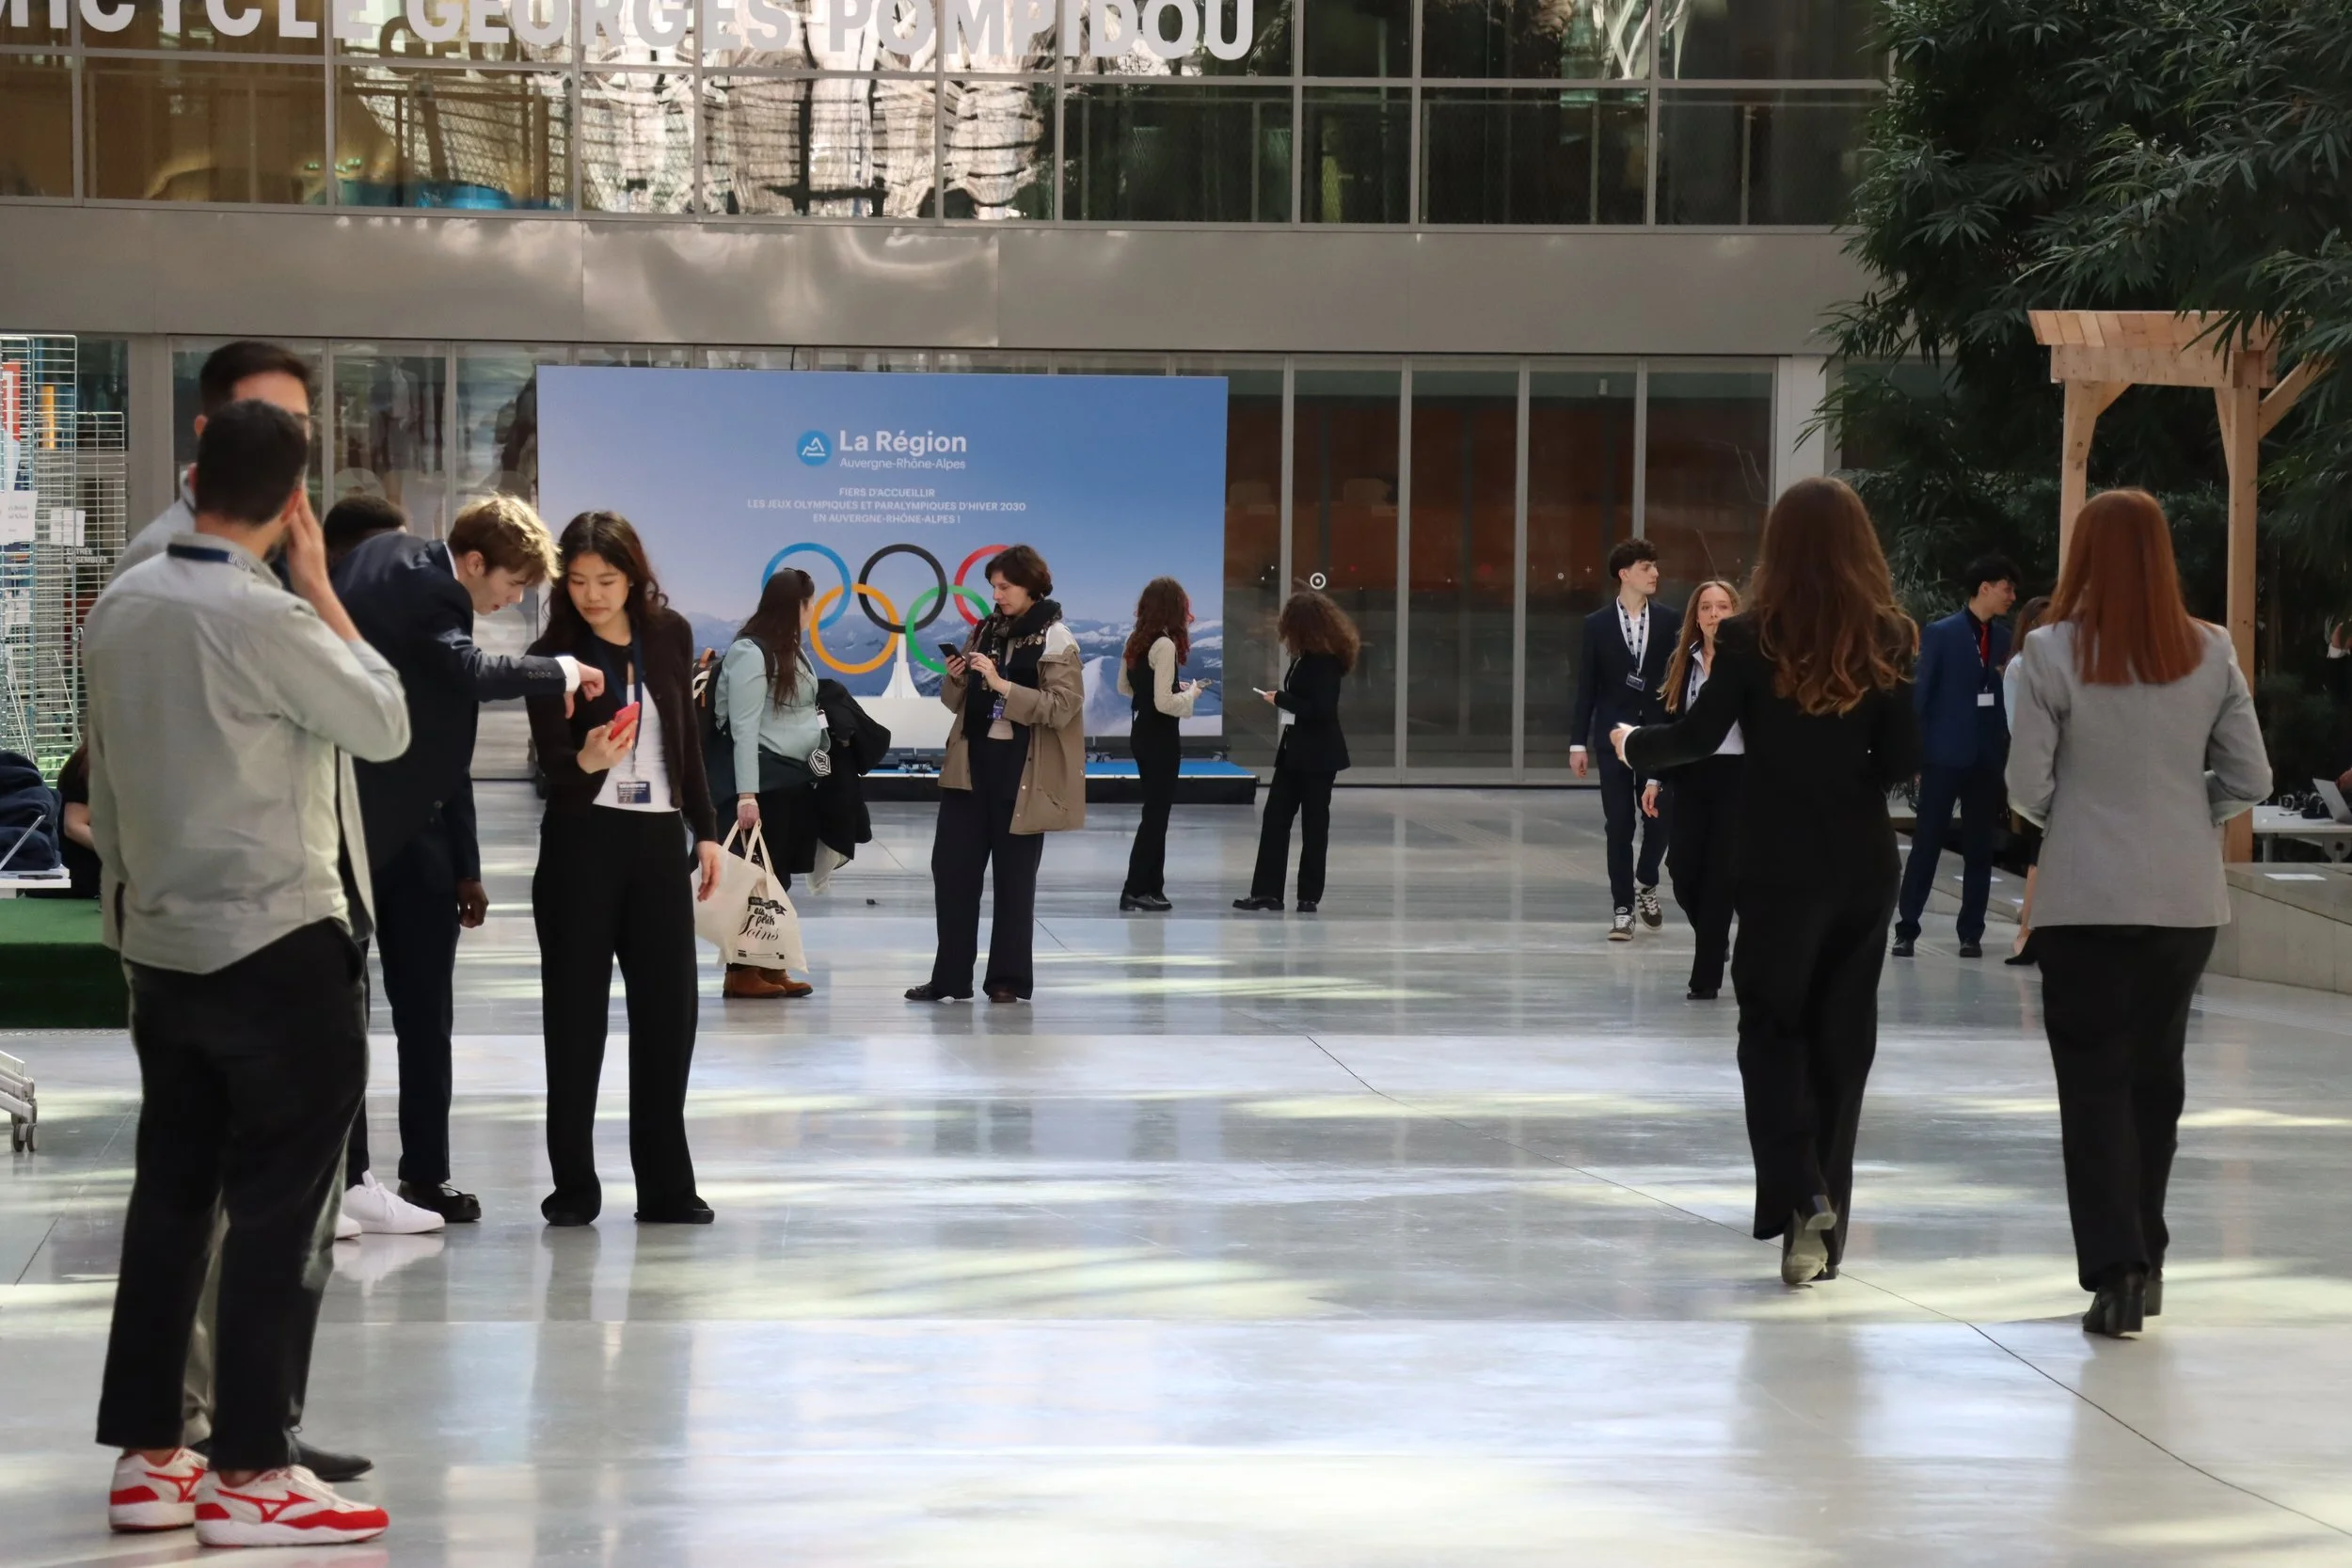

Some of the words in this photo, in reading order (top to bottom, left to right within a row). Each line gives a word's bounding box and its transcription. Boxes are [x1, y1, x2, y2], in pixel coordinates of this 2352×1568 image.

[405, 0, 792, 51] GEORGES
[829, 0, 1254, 60] POMPIDOU
[839, 430, 868, 451] La
[876, 430, 967, 457] Région
[839, 457, 966, 470] Auvergne-Rhône-Alpes
[839, 487, 866, 497] FIERS
[869, 488, 935, 497] D'ACCUEILLIR
[748, 499, 765, 508] LES
[769, 499, 791, 509] JEUX
[794, 500, 858, 510] OLYMPIQUES
[861, 500, 872, 509] ET
[875, 501, 957, 511] PARALYMPIQUES
[959, 501, 997, 511] D'HIVER
[1000, 502, 1025, 511] 2030
[813, 514, 826, 522] EN
[828, 513, 955, 524] AUVERGNE-RHÔNE-ALPES
[66, 546, 93, 555] ETRÉE
